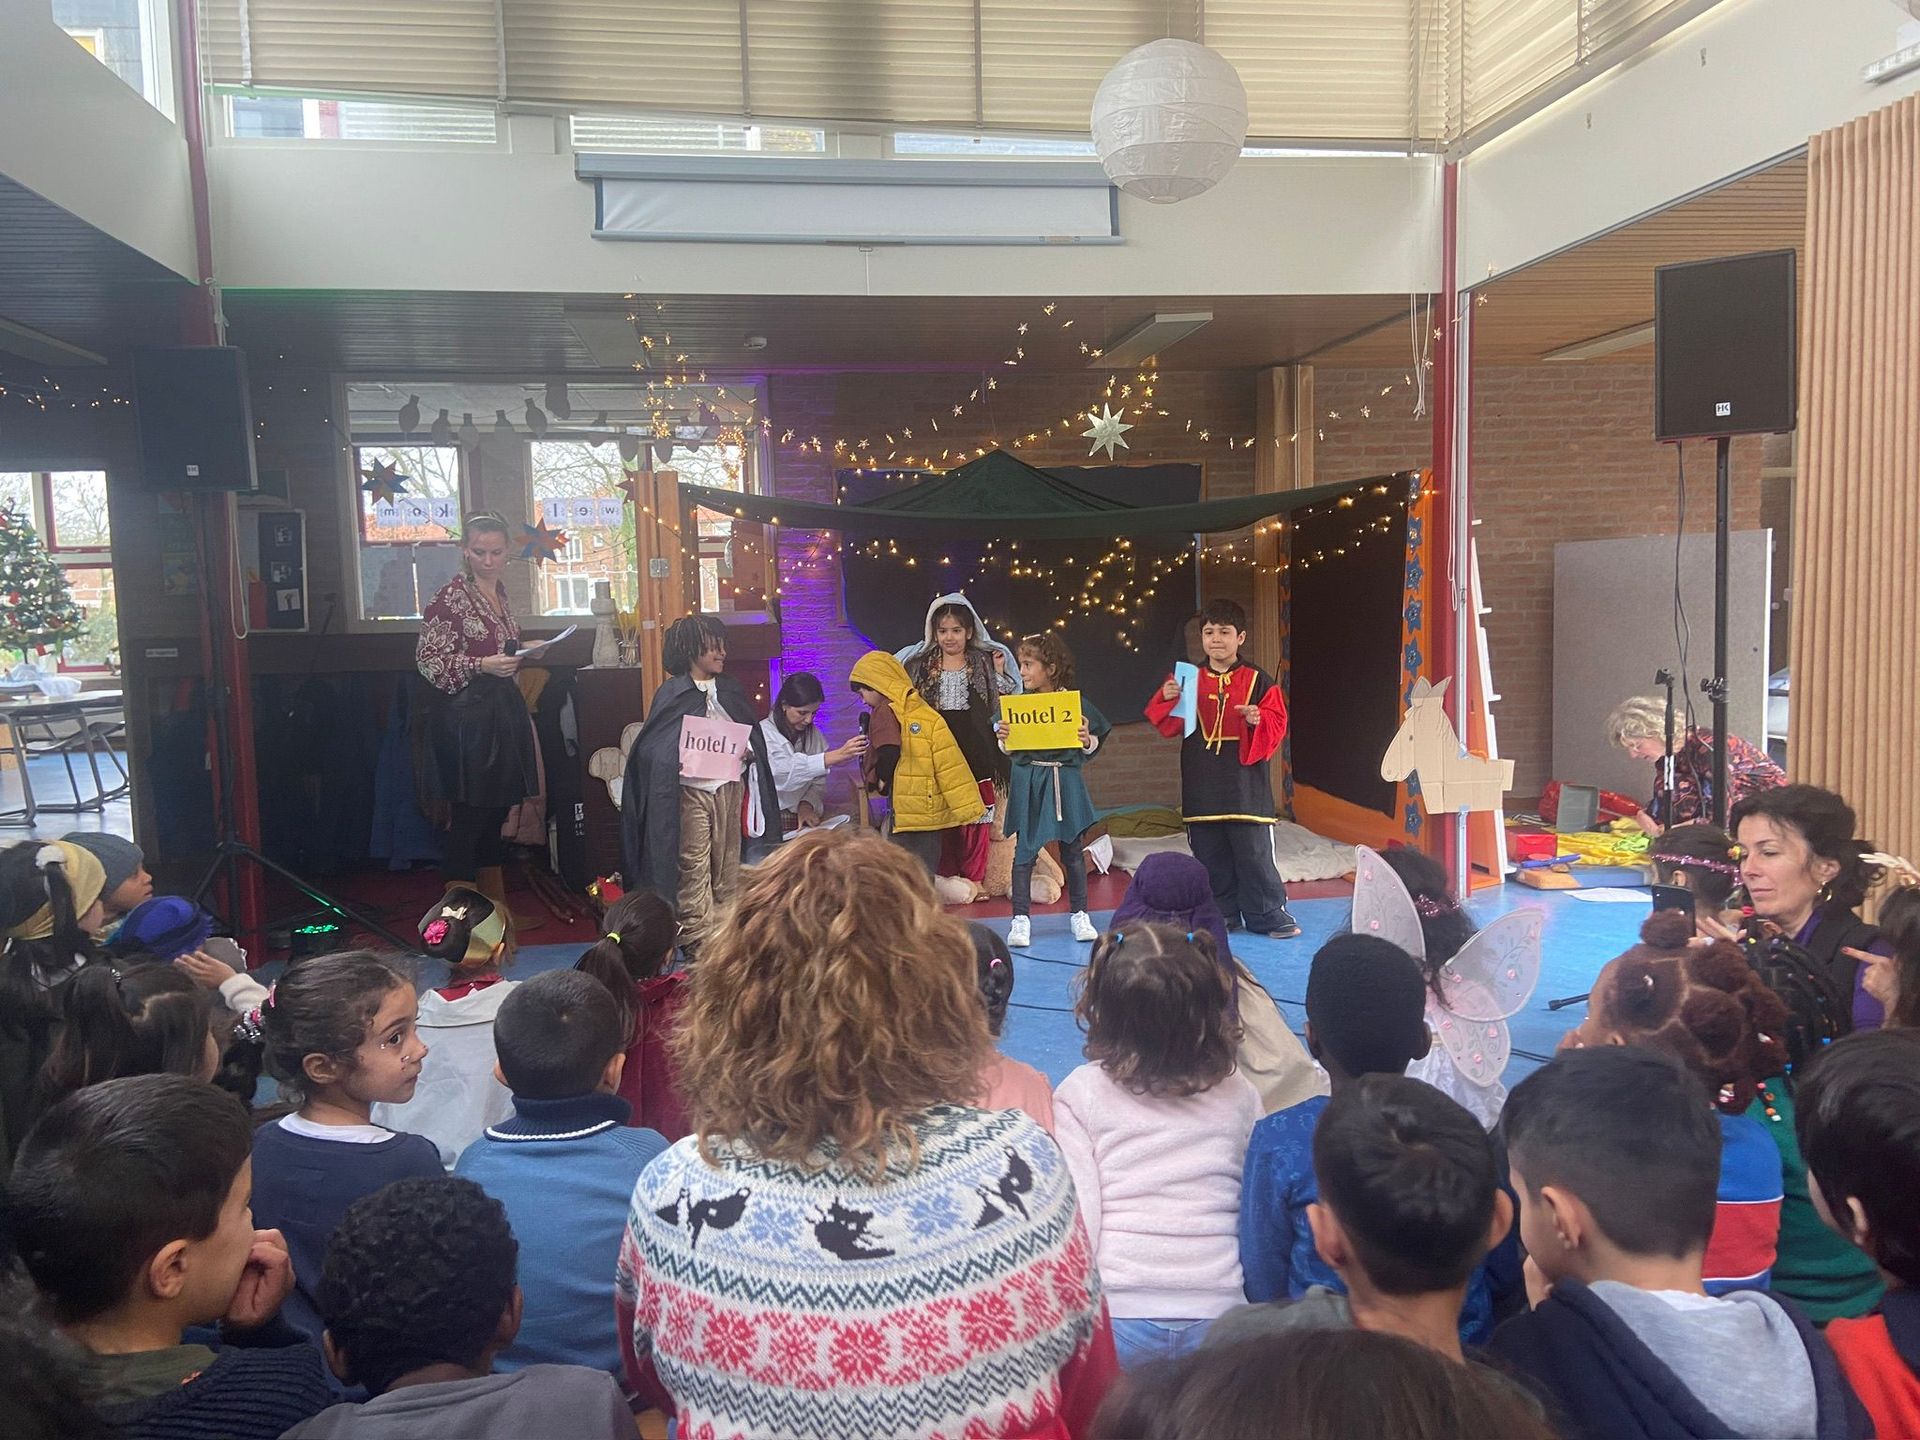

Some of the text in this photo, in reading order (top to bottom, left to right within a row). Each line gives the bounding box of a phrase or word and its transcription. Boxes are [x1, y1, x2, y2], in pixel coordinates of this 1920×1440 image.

[1717, 403, 1729, 412] HK
[1008, 706, 1073, 725] hotel 2
[684, 731, 737, 755] hotel 1
